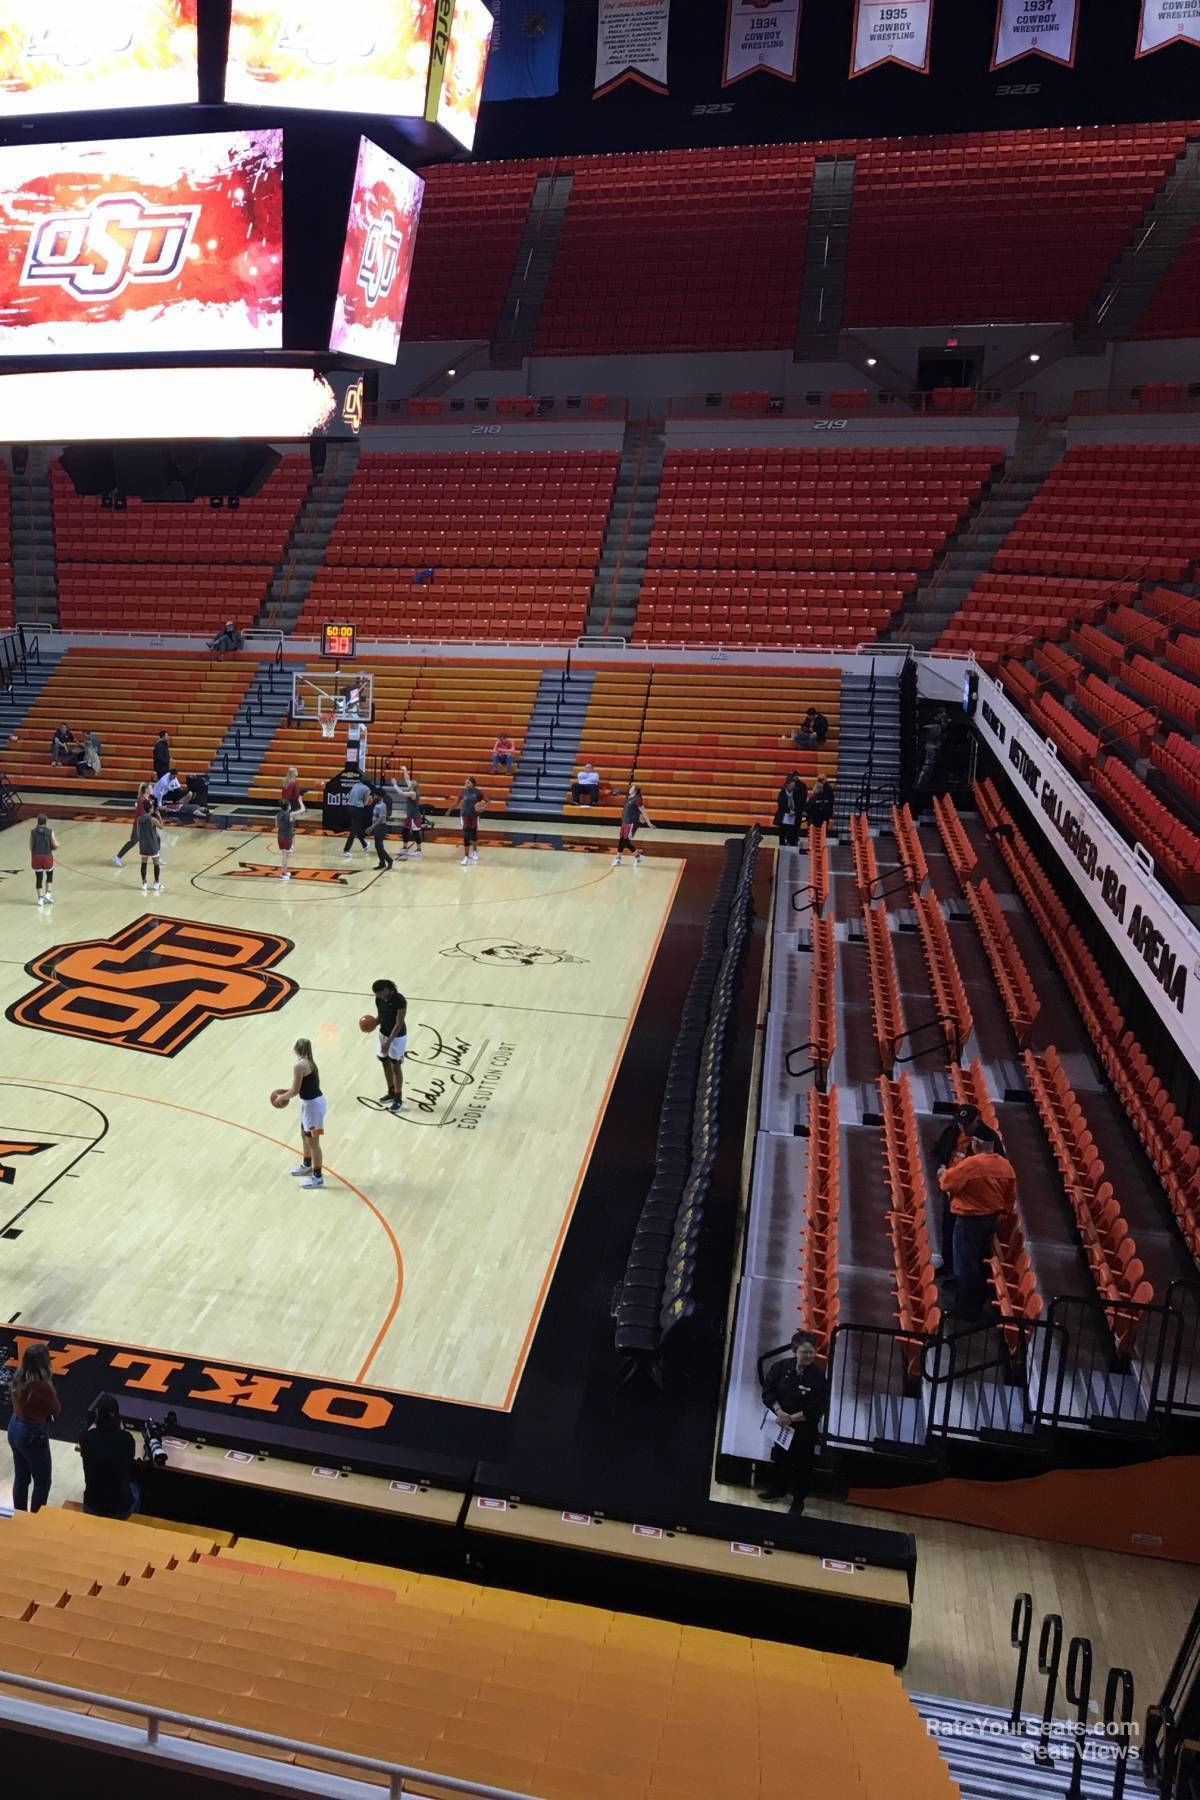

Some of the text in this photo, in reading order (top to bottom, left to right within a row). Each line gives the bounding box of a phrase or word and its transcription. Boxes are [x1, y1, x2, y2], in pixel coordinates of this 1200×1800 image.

[880, 8, 908, 20] 1935
[1016, 14, 1057, 24] COWBOY
[750, 17, 778, 29] 1934
[873, 22, 912, 33] COWBOY
[1012, 23, 1060, 33] WRESTLING
[744, 31, 782, 41] COWBOY
[869, 32, 915, 41] WRESTLING
[741, 40, 784, 50] WRESTLING
[994, 83, 1043, 96] 326
[692, 103, 735, 115] 325
[19, 191, 202, 302] OSU
[814, 419, 849, 430] 219
[327, 626, 353, 637] 60:00
[1127, 904, 1188, 1014] ARENA
[457, 1041, 519, 1130] EDDIE SUTTON COURT
